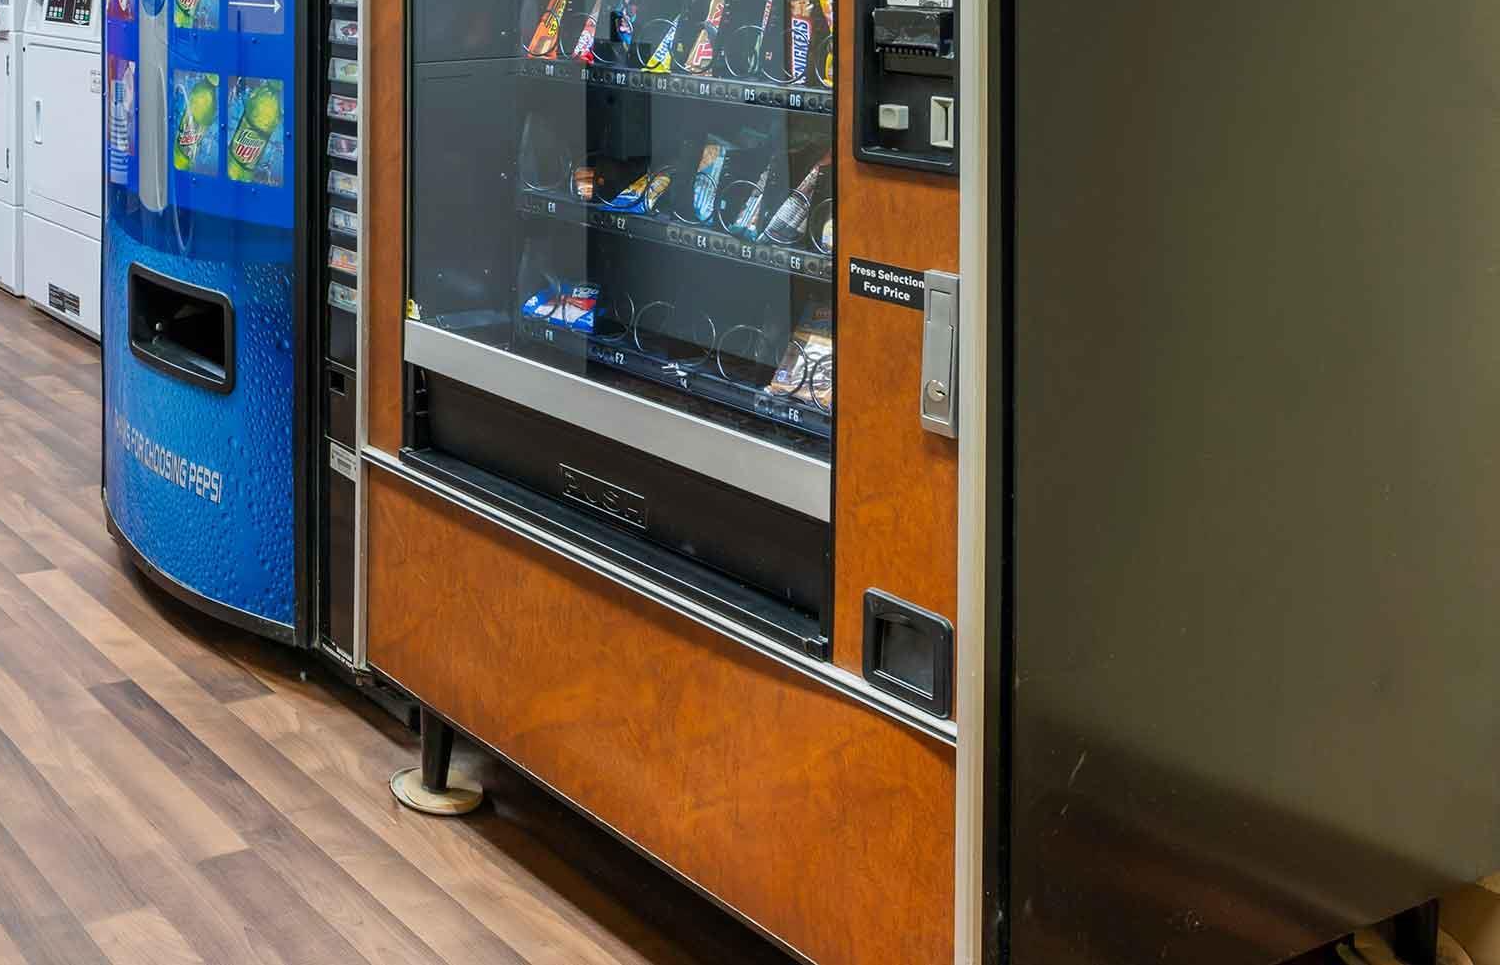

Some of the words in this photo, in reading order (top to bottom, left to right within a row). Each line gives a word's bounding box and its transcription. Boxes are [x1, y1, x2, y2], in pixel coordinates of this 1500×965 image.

[697, 236, 707, 248] E4
[742, 245, 751, 259] E5
[791, 256, 800, 270] E6
[850, 262, 877, 279] Press
[877, 269, 925, 289] Selection
[863, 281, 882, 295] For
[883, 284, 911, 302] Price
[615, 352, 624, 365] F2
[788, 408, 799, 422] F6
[144, 438, 187, 489] CHOOSING
[188, 462, 222, 504] PEPSI
